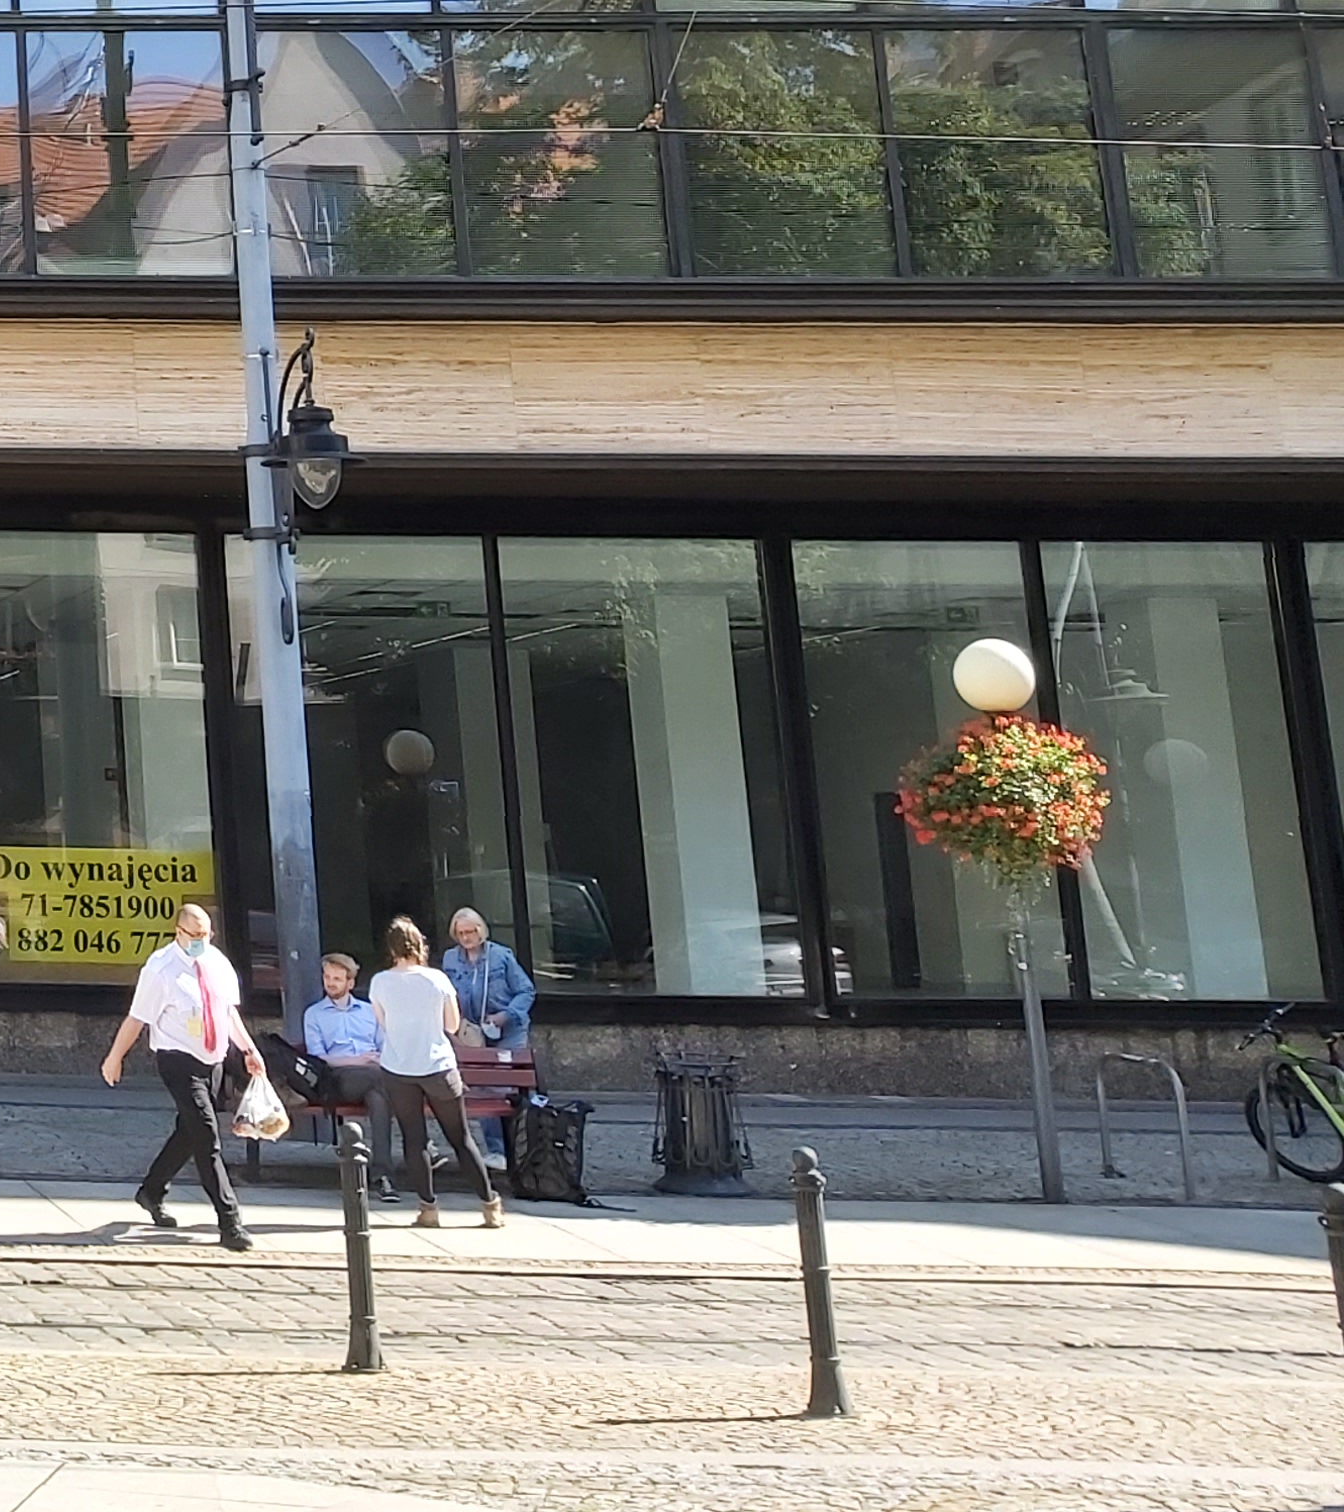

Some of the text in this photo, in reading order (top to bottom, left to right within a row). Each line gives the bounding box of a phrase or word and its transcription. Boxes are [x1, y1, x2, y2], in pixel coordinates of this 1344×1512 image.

[41, 855, 197, 890] wynajęcia
[21, 893, 175, 920] 71-7851900
[17, 928, 64, 952] 882
[73, 929, 121, 954] 046
